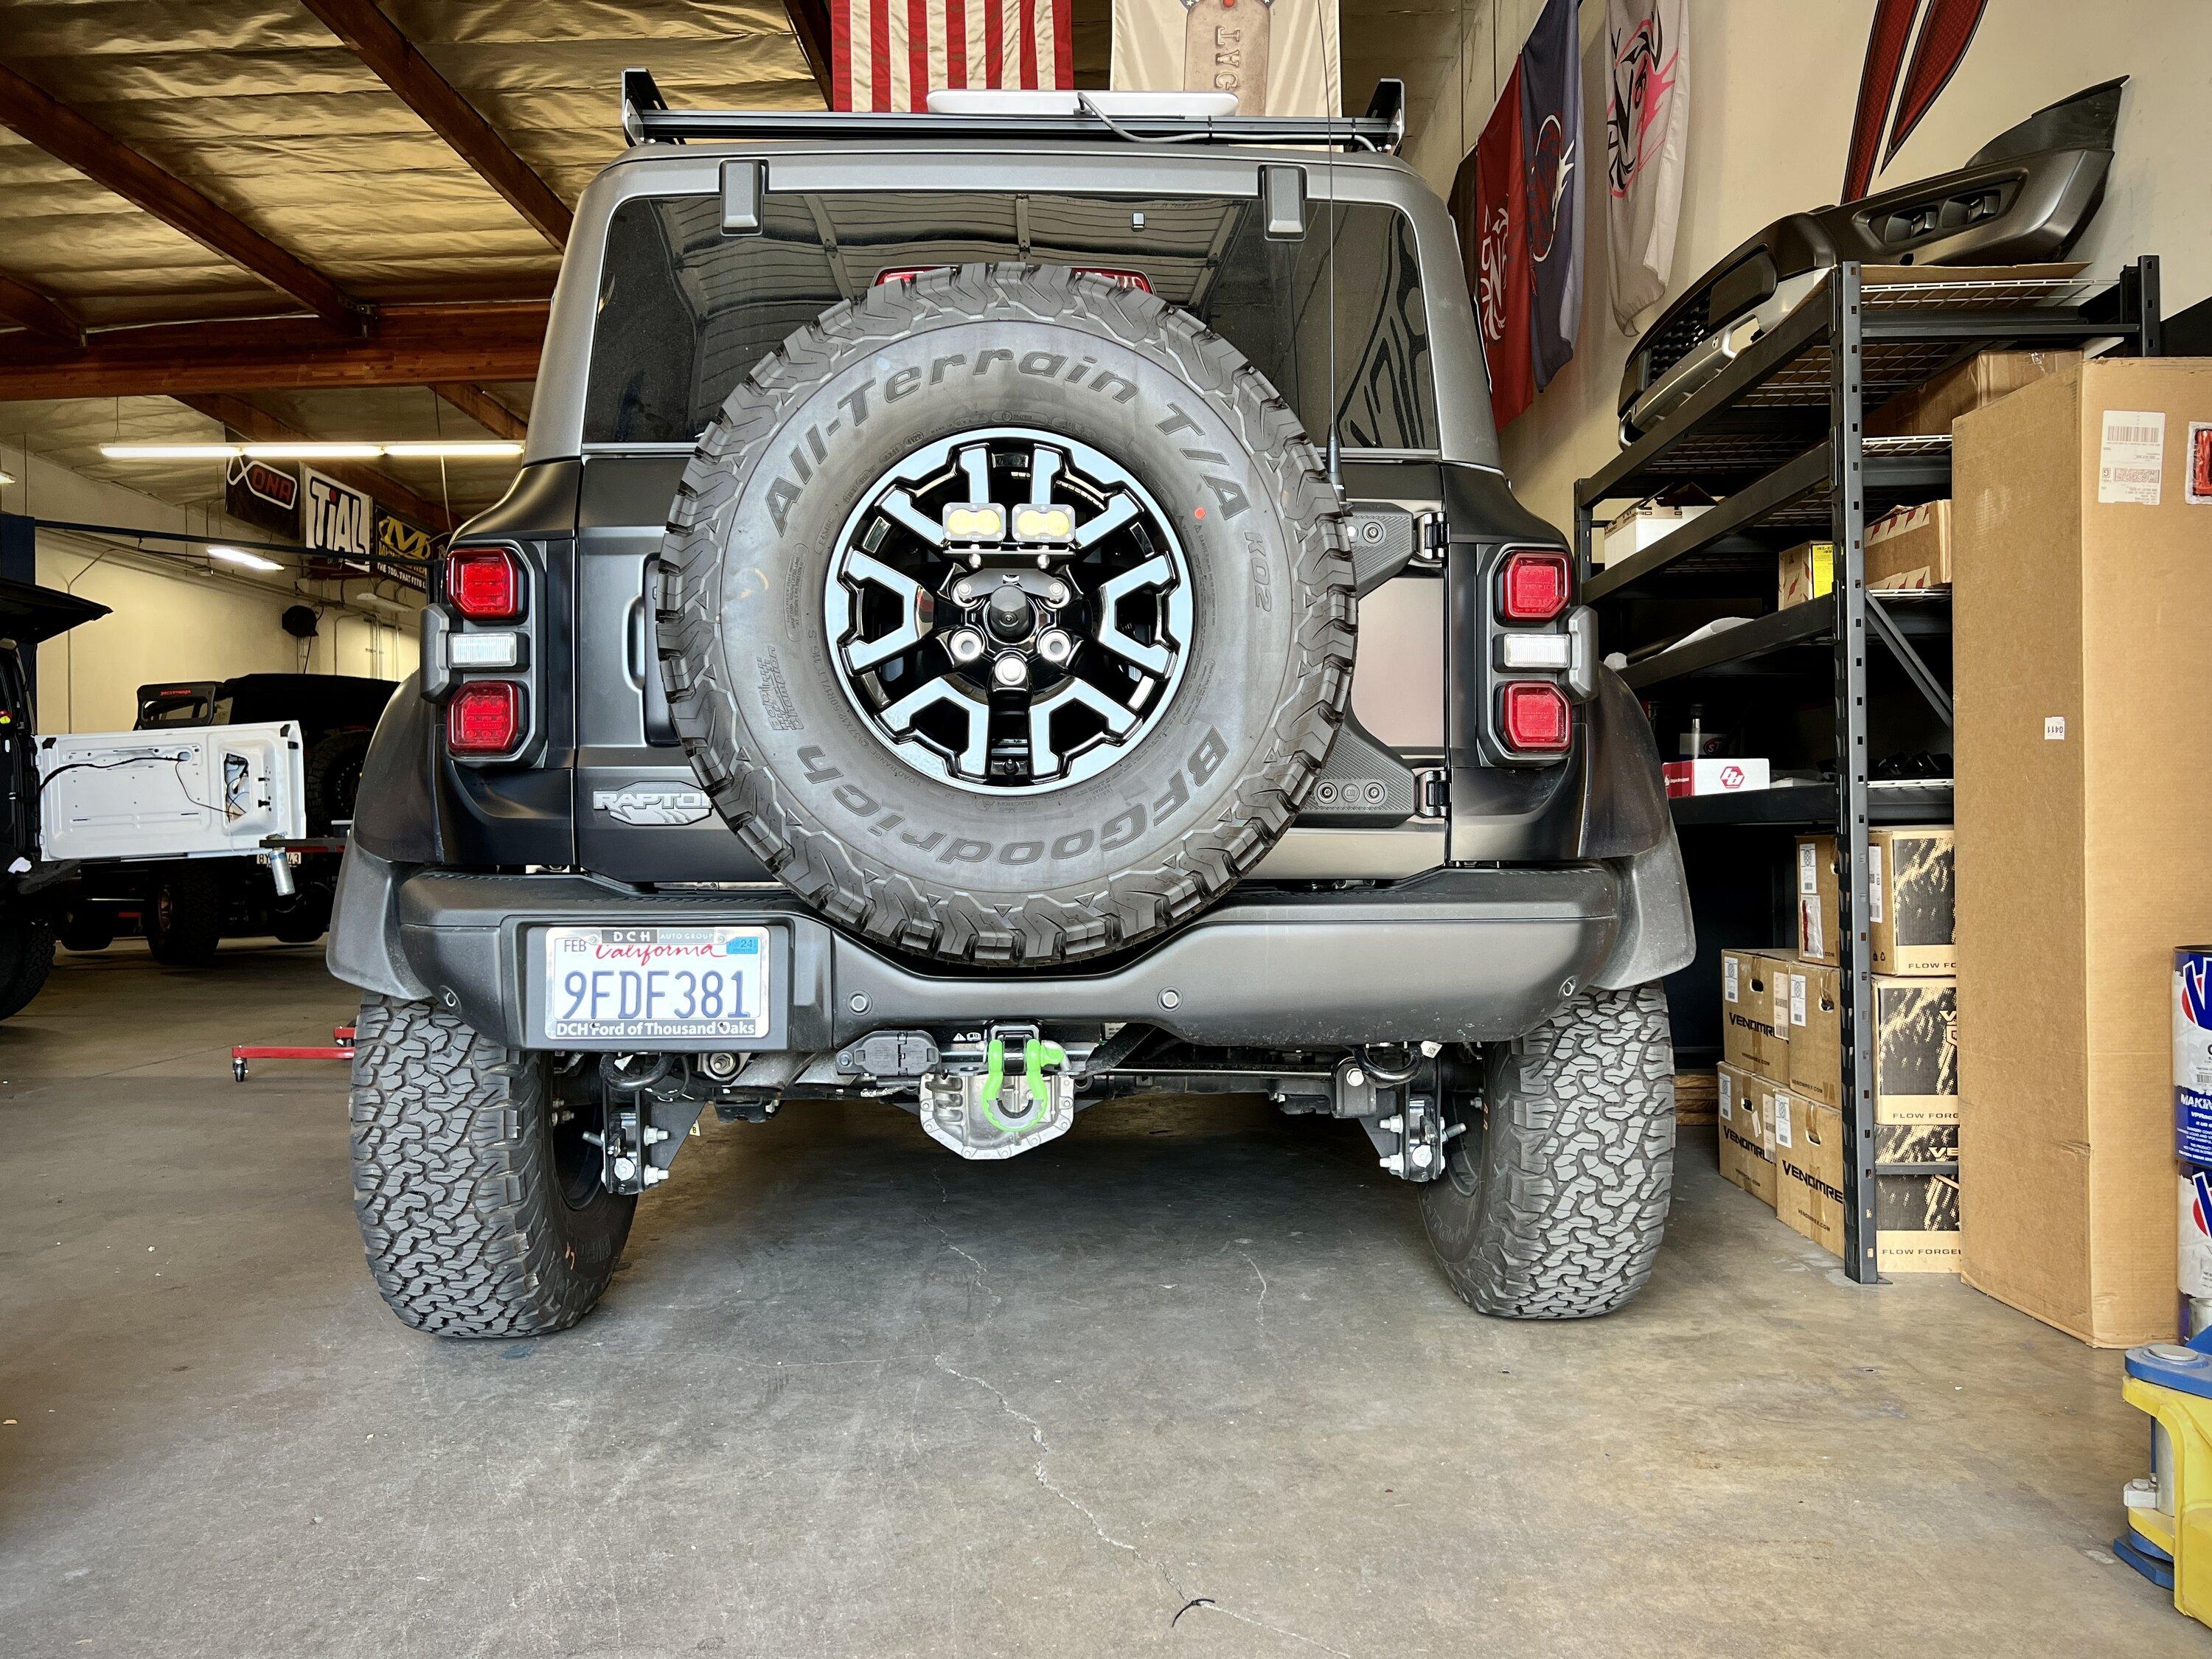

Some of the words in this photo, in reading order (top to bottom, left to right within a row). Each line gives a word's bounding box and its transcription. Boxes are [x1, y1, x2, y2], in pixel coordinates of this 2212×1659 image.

[765, 347, 1140, 538] All-Terrain
[796, 723, 1230, 866] BFGoodrich
[259, 853, 299, 864] 8Y43
[613, 931, 650, 942] DCH
[564, 940, 586, 952] FEB
[740, 939, 753, 948] 24
[563, 970, 751, 1020] 9FDF381
[556, 1023, 589, 1036] DCH
[591, 1022, 628, 1036] Ford
[630, 1022, 644, 1036] of
[644, 1022, 715, 1036] Thousand
[720, 1022, 755, 1036] Oaks
